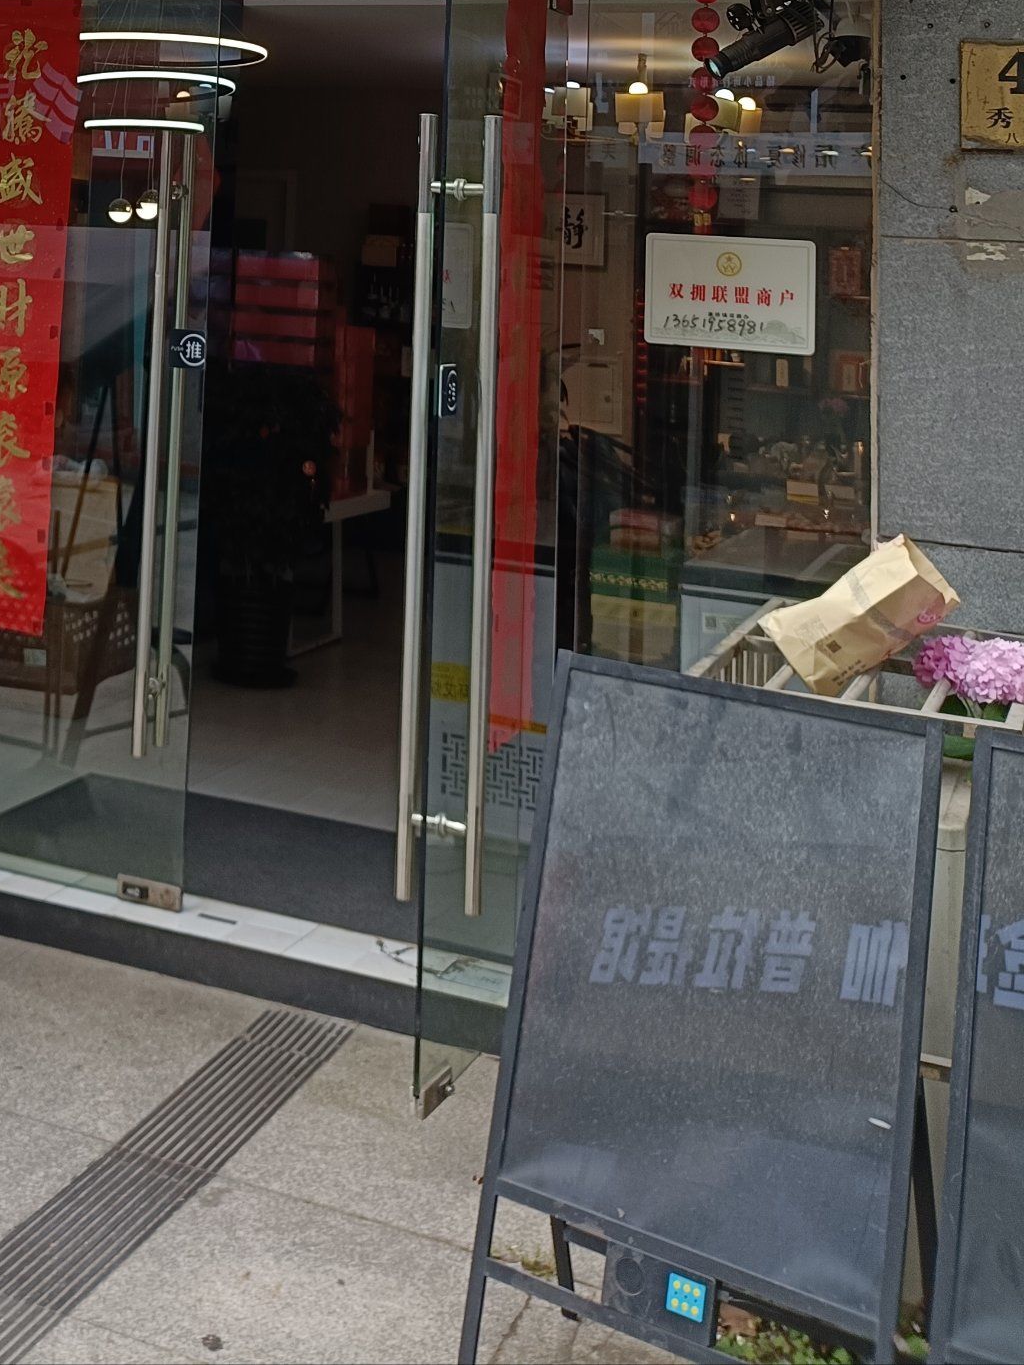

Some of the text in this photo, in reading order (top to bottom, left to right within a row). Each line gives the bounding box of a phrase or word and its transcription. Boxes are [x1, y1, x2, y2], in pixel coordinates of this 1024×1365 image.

[985, 107, 1014, 129] 秀
[668, 282, 795, 307] 双拥联盟商户
[663, 313, 764, 337] 13651958981
[185, 340, 202, 359] 推
